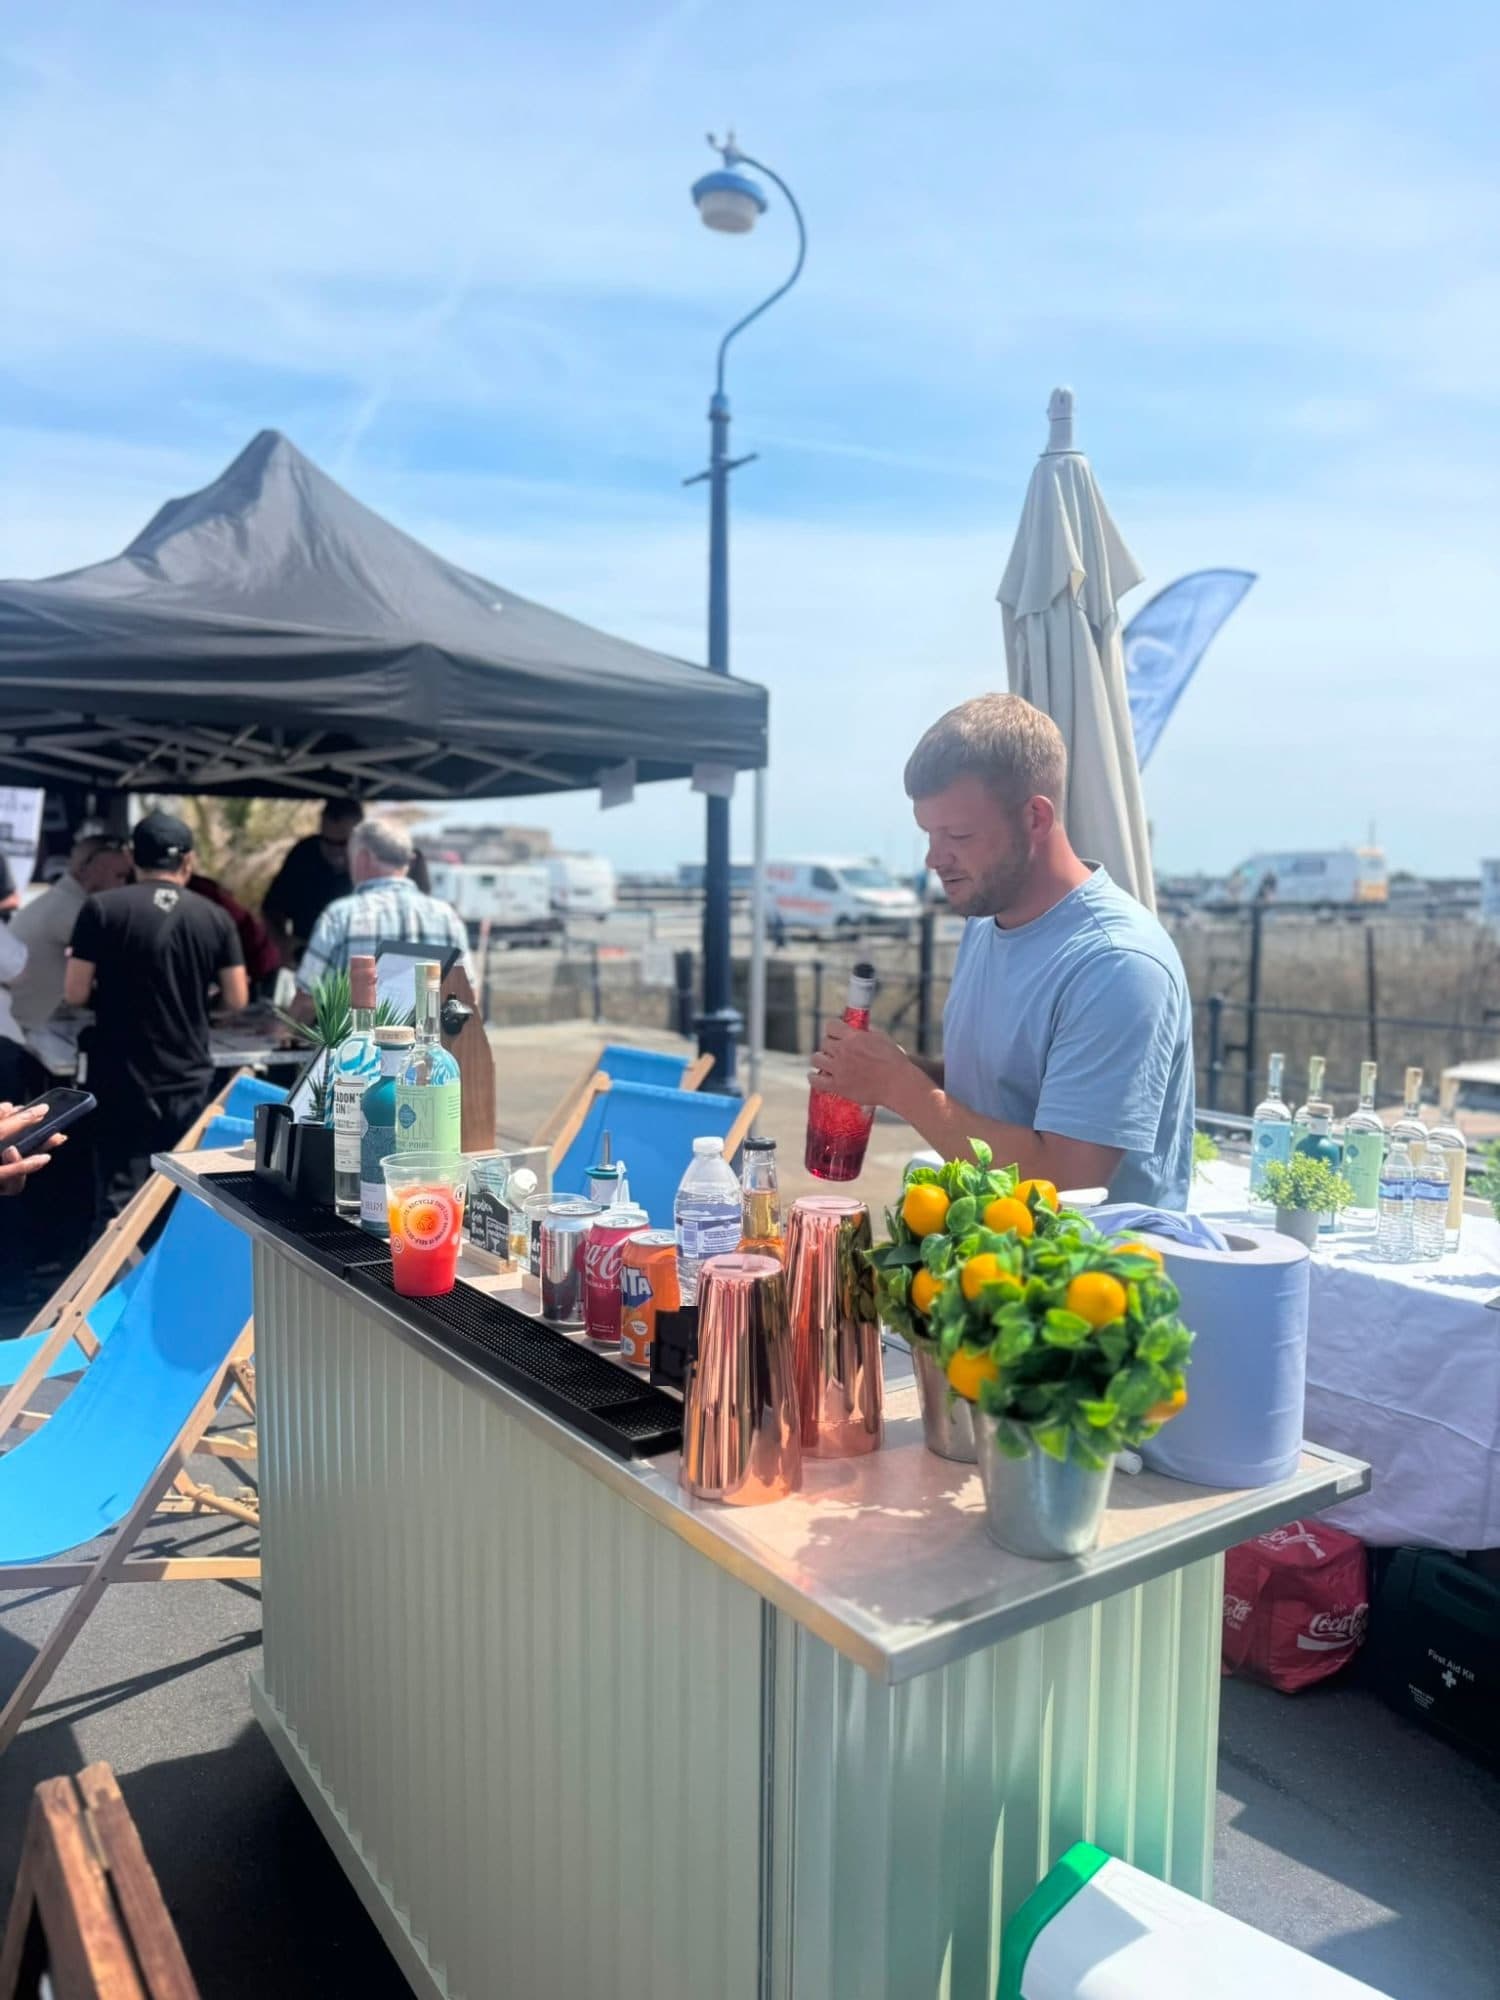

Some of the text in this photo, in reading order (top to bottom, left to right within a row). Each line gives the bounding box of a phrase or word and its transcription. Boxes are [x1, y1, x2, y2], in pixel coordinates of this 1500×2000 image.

[1427, 1648, 1475, 1682] First Aid Kit
